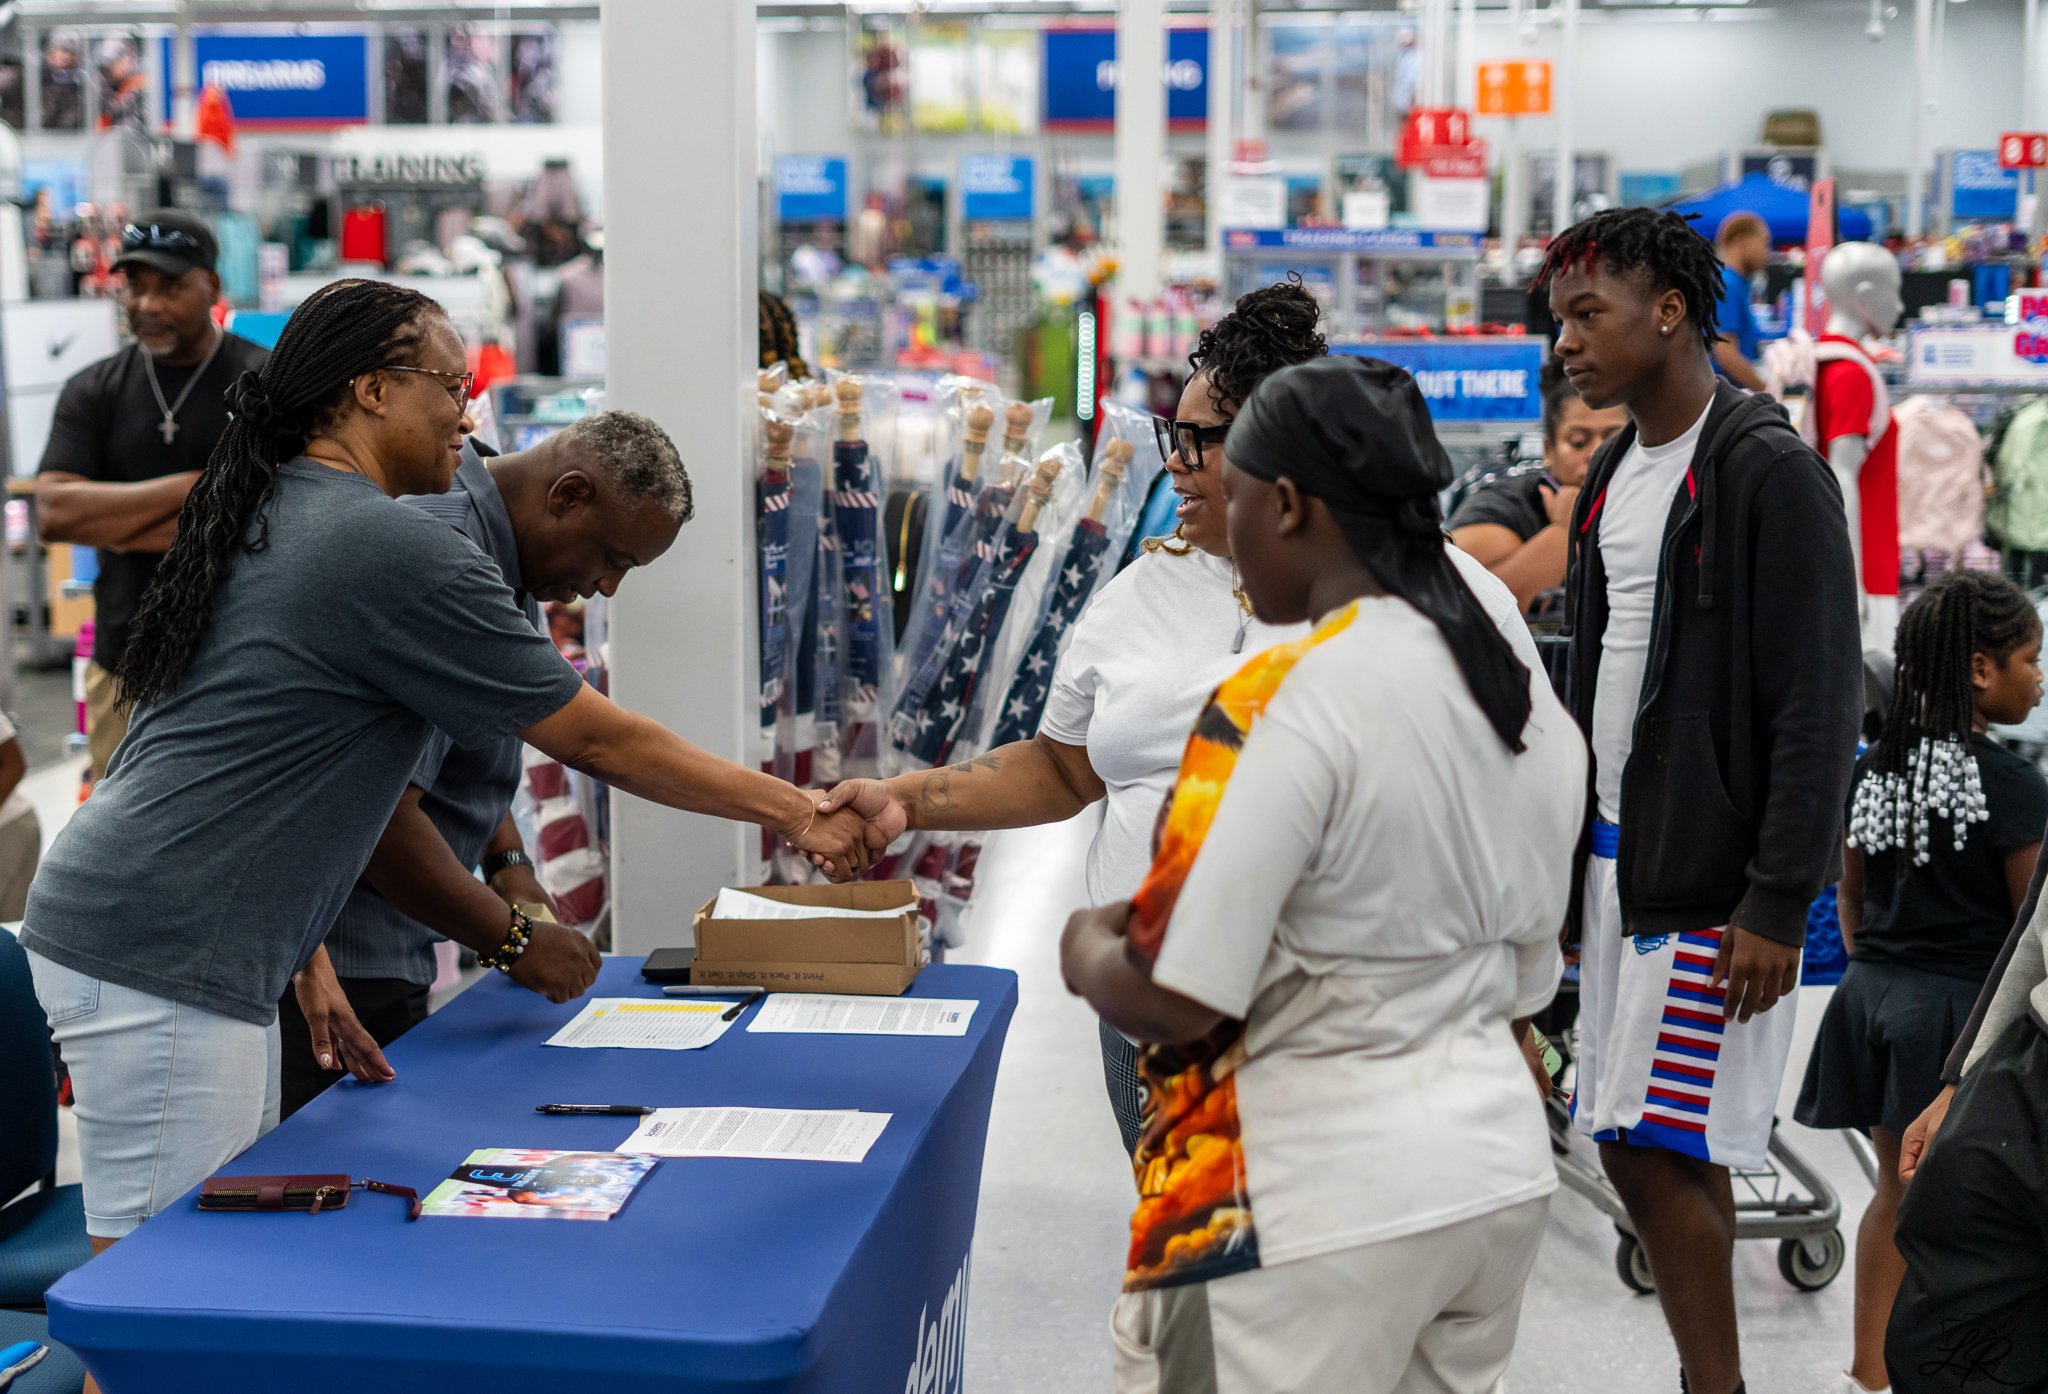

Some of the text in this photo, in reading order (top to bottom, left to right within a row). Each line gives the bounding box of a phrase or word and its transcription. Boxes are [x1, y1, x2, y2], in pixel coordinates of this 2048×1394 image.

[1461, 369, 1528, 398] THERE
[708, 970, 724, 979] Get
[736, 970, 757, 979] Ship
[769, 970, 790, 980] Pack
[803, 970, 824, 980] Print
